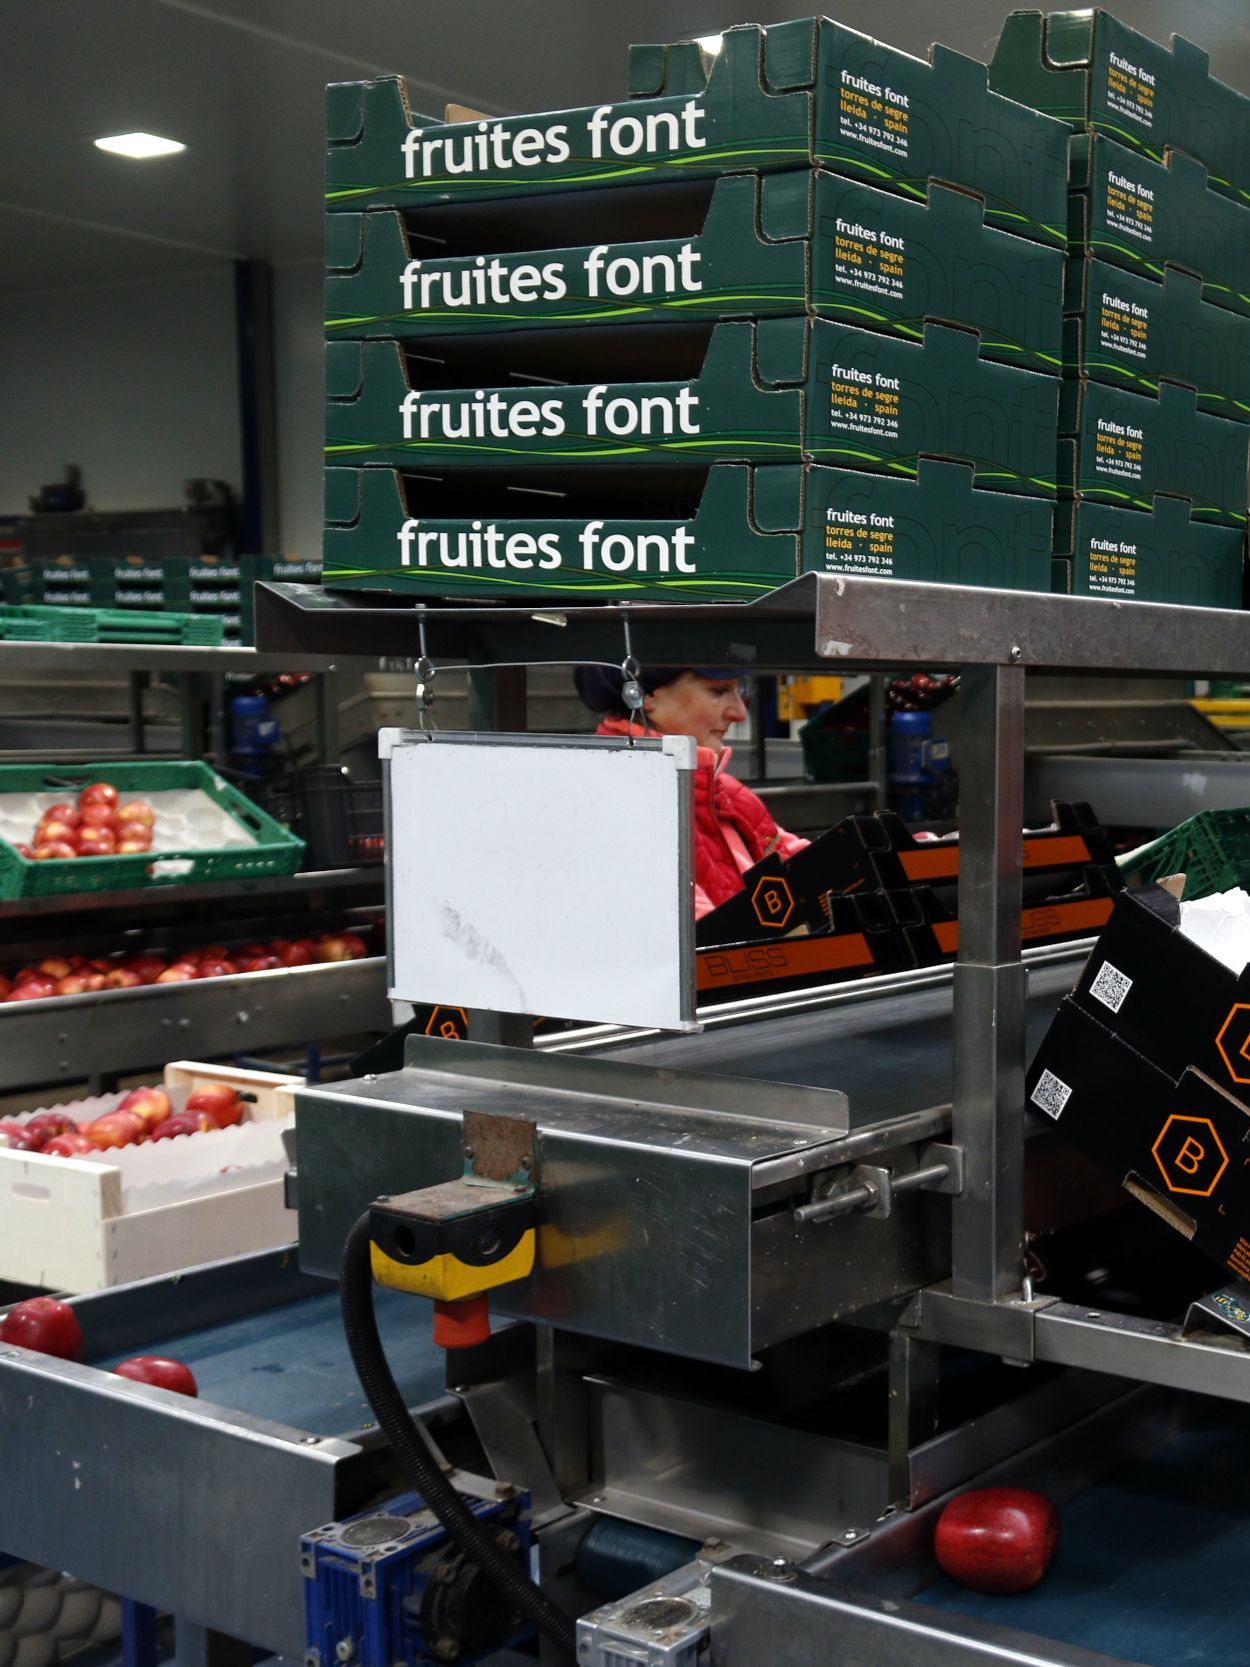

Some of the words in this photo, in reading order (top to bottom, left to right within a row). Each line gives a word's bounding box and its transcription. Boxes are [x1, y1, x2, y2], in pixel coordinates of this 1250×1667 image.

[1110, 52, 1137, 76] fruites
[1139, 68, 1155, 86] font
[842, 70, 882, 97] fruites
[885, 87, 909, 108] font
[1108, 77, 1126, 93] lleida
[1137, 94, 1153, 107] spain
[1109, 67, 1128, 83] torres
[1129, 78, 1137, 88] de
[1138, 84, 1154, 97] segre
[841, 88, 869, 106] torres
[871, 99, 883, 111] de
[885, 106, 908, 121] segre
[841, 100, 867, 119] lleida
[884, 119, 907, 134] spain
[401, 122, 570, 178] fruites
[587, 101, 706, 158] font
[840, 116, 852, 127] tel.
[855, 122, 867, 132] +34
[868, 126, 880, 137] 973
[882, 131, 894, 142] 792
[897, 136, 908, 147] 346
[840, 128, 908, 157] www.fruitesfont.com
[1108, 171, 1135, 192] fruites
[1137, 184, 1154, 201] font
[1107, 196, 1125, 211] lleida
[1136, 210, 1152, 222] spain
[1108, 186, 1126, 200] torres
[1128, 194, 1136, 204] de
[1137, 200, 1153, 212] segre
[836, 218, 877, 241] fruites
[880, 231, 904, 250] font
[836, 236, 864, 252] torres
[866, 245, 878, 256] de
[880, 250, 904, 263] segre
[836, 248, 862, 264] lleida
[880, 263, 903, 276] spain
[400, 256, 567, 309] fruites
[583, 243, 702, 297] font
[835, 264, 847, 273] tel.
[850, 268, 862, 277] +34
[864, 271, 876, 281] 973
[878, 275, 890, 285] 792
[892, 279, 903, 289] 346
[835, 276, 903, 299] www.fruitesfont.com
[1103, 293, 1129, 312] fruites
[1131, 303, 1148, 318] font
[1102, 308, 1121, 321] torres
[1122, 314, 1130, 323] de
[1131, 318, 1147, 329] segre
[1102, 317, 1119, 331] lleida
[1131, 329, 1146, 339] spain
[832, 364, 872, 384] fruites
[875, 373, 899, 390] font
[831, 393, 857, 407] lleida
[875, 404, 898, 415] spain
[832, 382, 859, 395] torres
[862, 388, 873, 398] de
[875, 392, 899, 404] segre
[399, 390, 565, 439] fruites
[582, 386, 699, 435] font
[831, 409, 843, 418] tel.
[845, 412, 857, 420] +34
[859, 414, 871, 423] 973
[873, 416, 885, 426] 792
[887, 419, 898, 428] 346
[831, 421, 898, 438] www.fruitesfont.com
[1098, 419, 1124, 435] fruites
[1126, 426, 1143, 439] font
[1097, 433, 1116, 444] torres
[1117, 438, 1125, 446] de
[1126, 441, 1142, 451] segre
[1097, 443, 1114, 454] lleida
[1126, 451, 1141, 460] spain
[827, 508, 867, 524] fruites
[870, 513, 894, 528] font
[397, 519, 562, 569] fruites
[579, 521, 695, 573] font
[826, 525, 854, 537] torres
[856, 528, 867, 538] de
[870, 531, 893, 542] segre
[826, 537, 852, 549] lleida
[870, 543, 892, 553] spain
[1091, 538, 1118, 552] fruites
[1120, 542, 1136, 555] font
[826, 564, 893, 575] www.fruitesfont.com
[854, 554, 866, 563] 973
[868, 556, 880, 564] 792
[881, 557, 893, 565] 346
[1090, 553, 1109, 562] torres
[1110, 555, 1118, 563] de
[1120, 557, 1136, 566] segre
[1090, 562, 1108, 572] lleida
[1119, 567, 1135, 576] spain
[764, 890, 782, 914] B
[704, 947, 788, 977] BLISS
[1174, 1136, 1205, 1174] B
